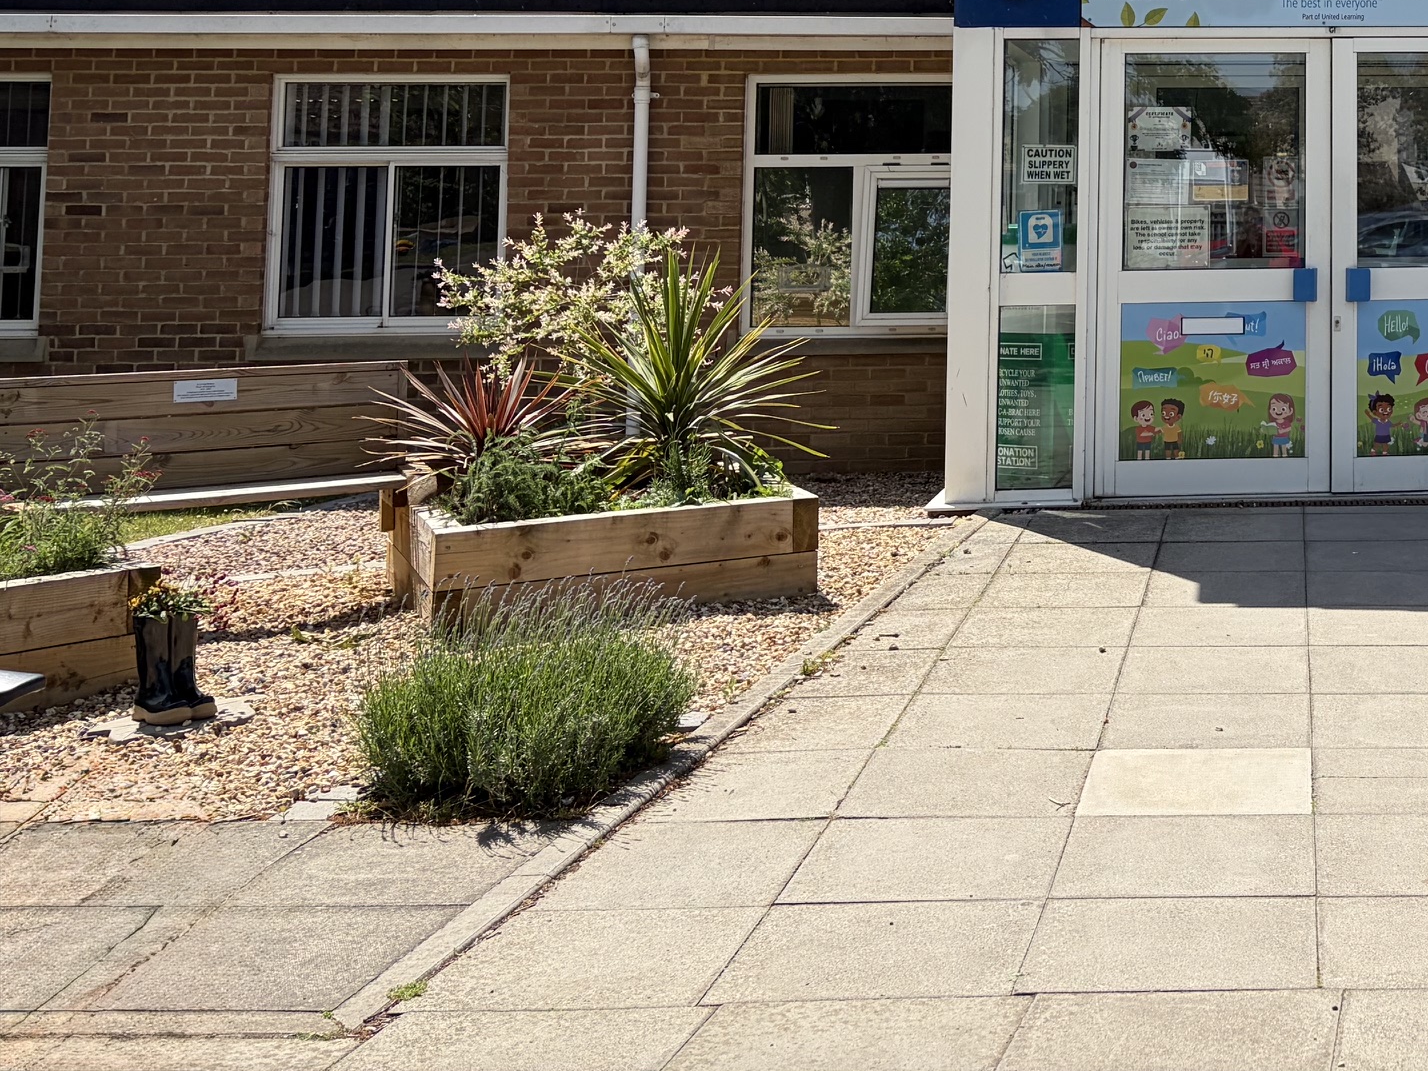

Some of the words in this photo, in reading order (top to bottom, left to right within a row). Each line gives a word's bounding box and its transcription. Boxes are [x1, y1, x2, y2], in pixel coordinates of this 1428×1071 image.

[1340, 13, 1365, 21] Learning
[1026, 148, 1072, 158] CAUTION
[1028, 160, 1070, 169] SLIPPERY
[1026, 170, 1051, 180] WHEN
[1053, 170, 1071, 179] WET
[1245, 318, 1260, 333] ut!
[1384, 314, 1409, 336] Hello!
[1020, 347, 1040, 356] HERE
[1019, 369, 1036, 378] YOUR
[1020, 389, 1037, 398] TOYS,
[1208, 389, 1239, 405] 你好
[998, 398, 1030, 407] UNWANTED
[1024, 408, 1040, 417] HERE
[1023, 418, 1041, 427] YOUR
[1015, 428, 1036, 436] CAUSE
[998, 446, 1035, 457] ONATION
[997, 456, 1031, 467] STATION
